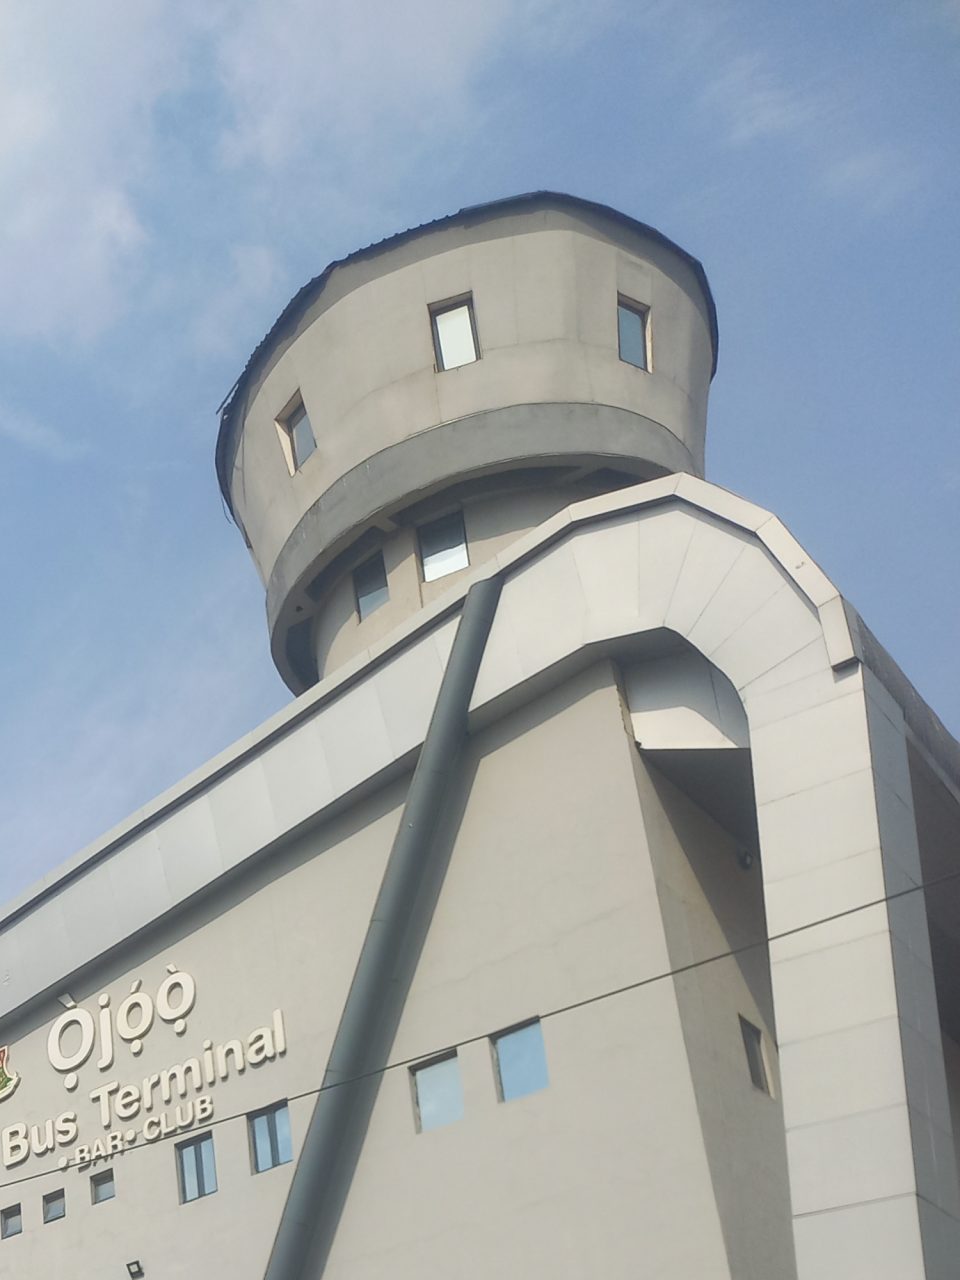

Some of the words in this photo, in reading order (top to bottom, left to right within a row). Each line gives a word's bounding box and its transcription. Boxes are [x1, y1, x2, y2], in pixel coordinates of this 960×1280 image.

[1, 1111, 78, 1168] Bus
[90, 1008, 287, 1128] Terminal
[75, 1130, 124, 1166] BAR
[142, 1095, 214, 1141] CLUB
